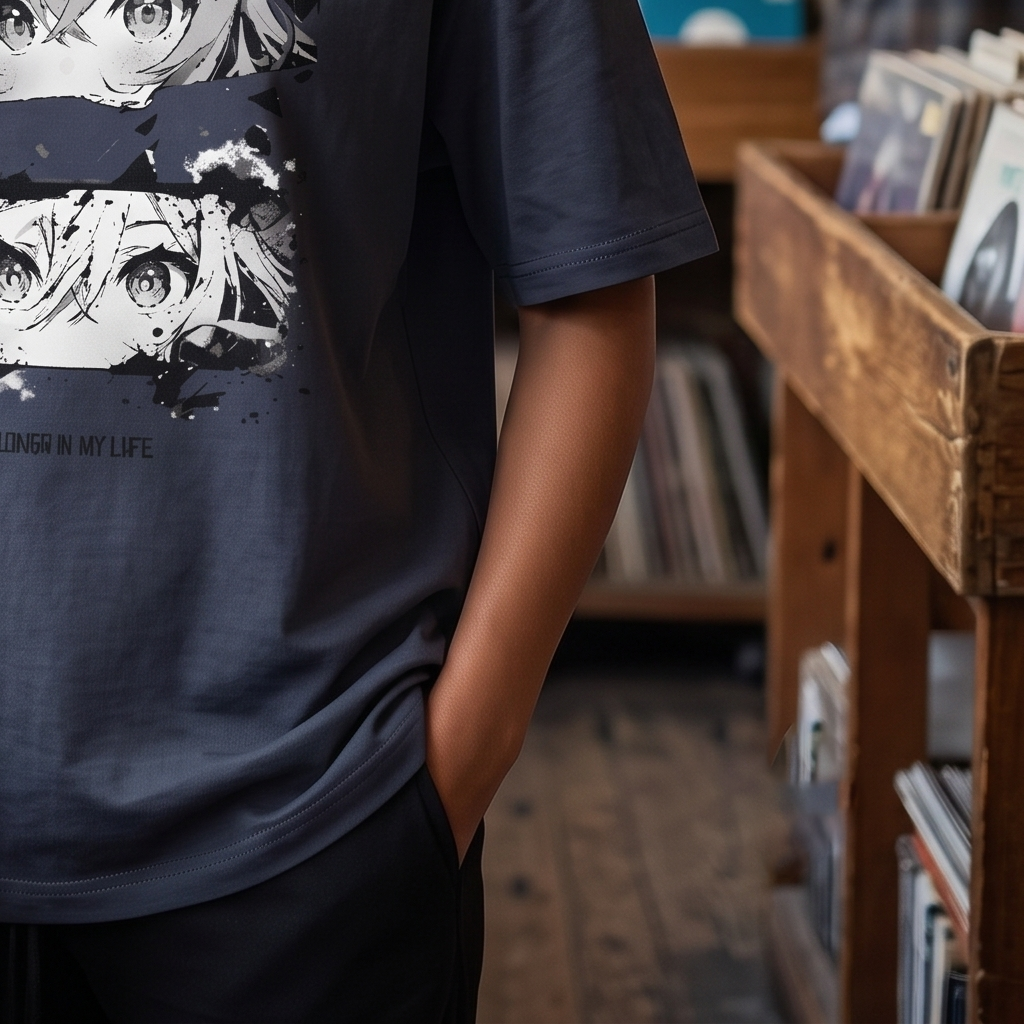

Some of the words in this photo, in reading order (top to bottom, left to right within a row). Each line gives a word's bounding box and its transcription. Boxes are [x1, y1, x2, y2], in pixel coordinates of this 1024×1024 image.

[57, 433, 73, 456] IN
[78, 435, 107, 457] MY
[110, 435, 154, 459] LIFE
